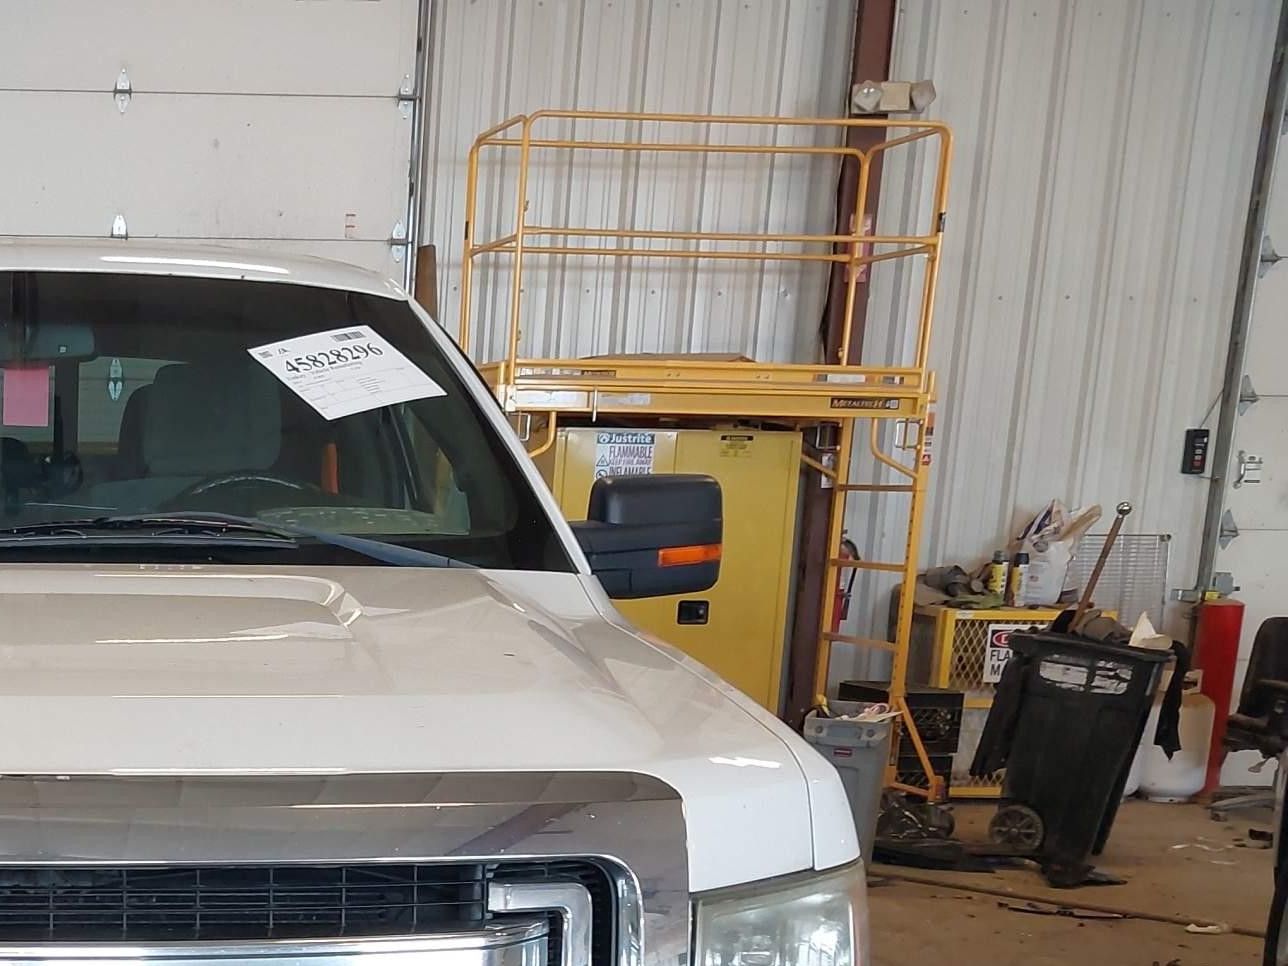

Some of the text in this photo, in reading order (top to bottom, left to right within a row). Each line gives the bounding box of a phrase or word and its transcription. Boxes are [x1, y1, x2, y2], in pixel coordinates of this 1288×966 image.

[285, 343, 384, 373] 45828296
[610, 433, 652, 444] Justrite
[609, 446, 653, 458] FLAMMABLE
